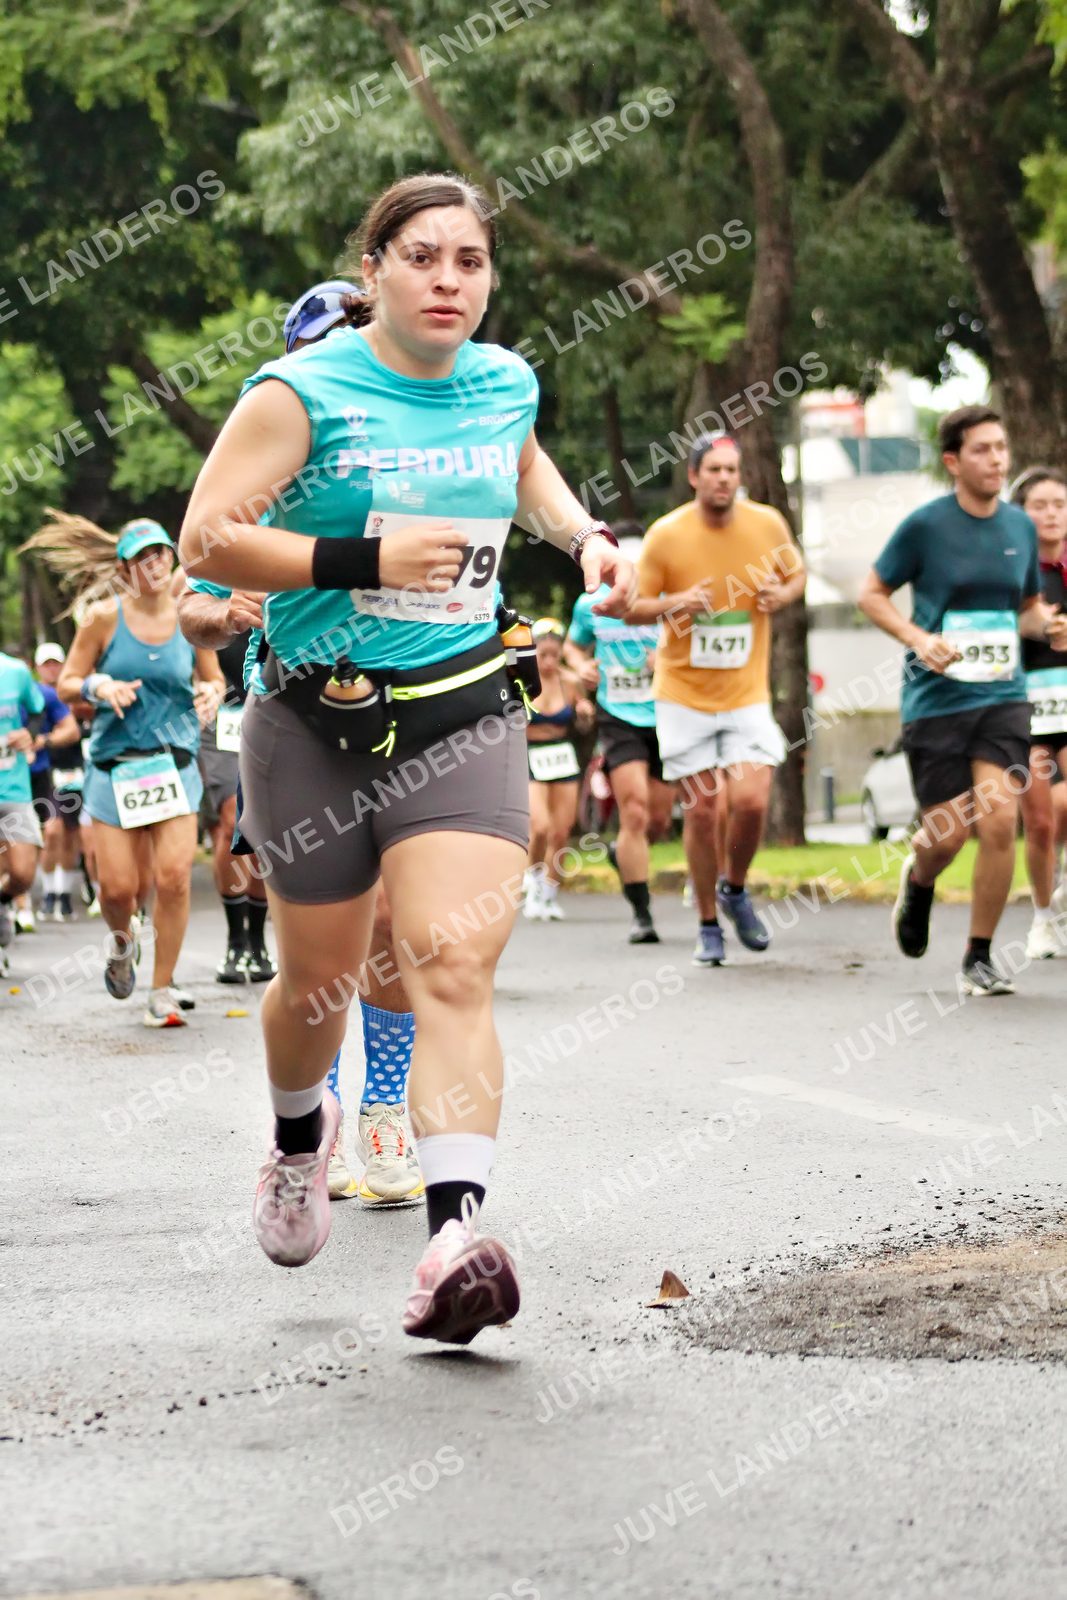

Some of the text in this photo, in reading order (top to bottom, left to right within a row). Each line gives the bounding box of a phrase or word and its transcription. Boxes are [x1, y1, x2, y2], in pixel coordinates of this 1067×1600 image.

[478, 410, 521, 426] BROOKS
[453, 546, 497, 589] 79
[700, 636, 745, 653] 1471
[123, 783, 178, 810] 6221
